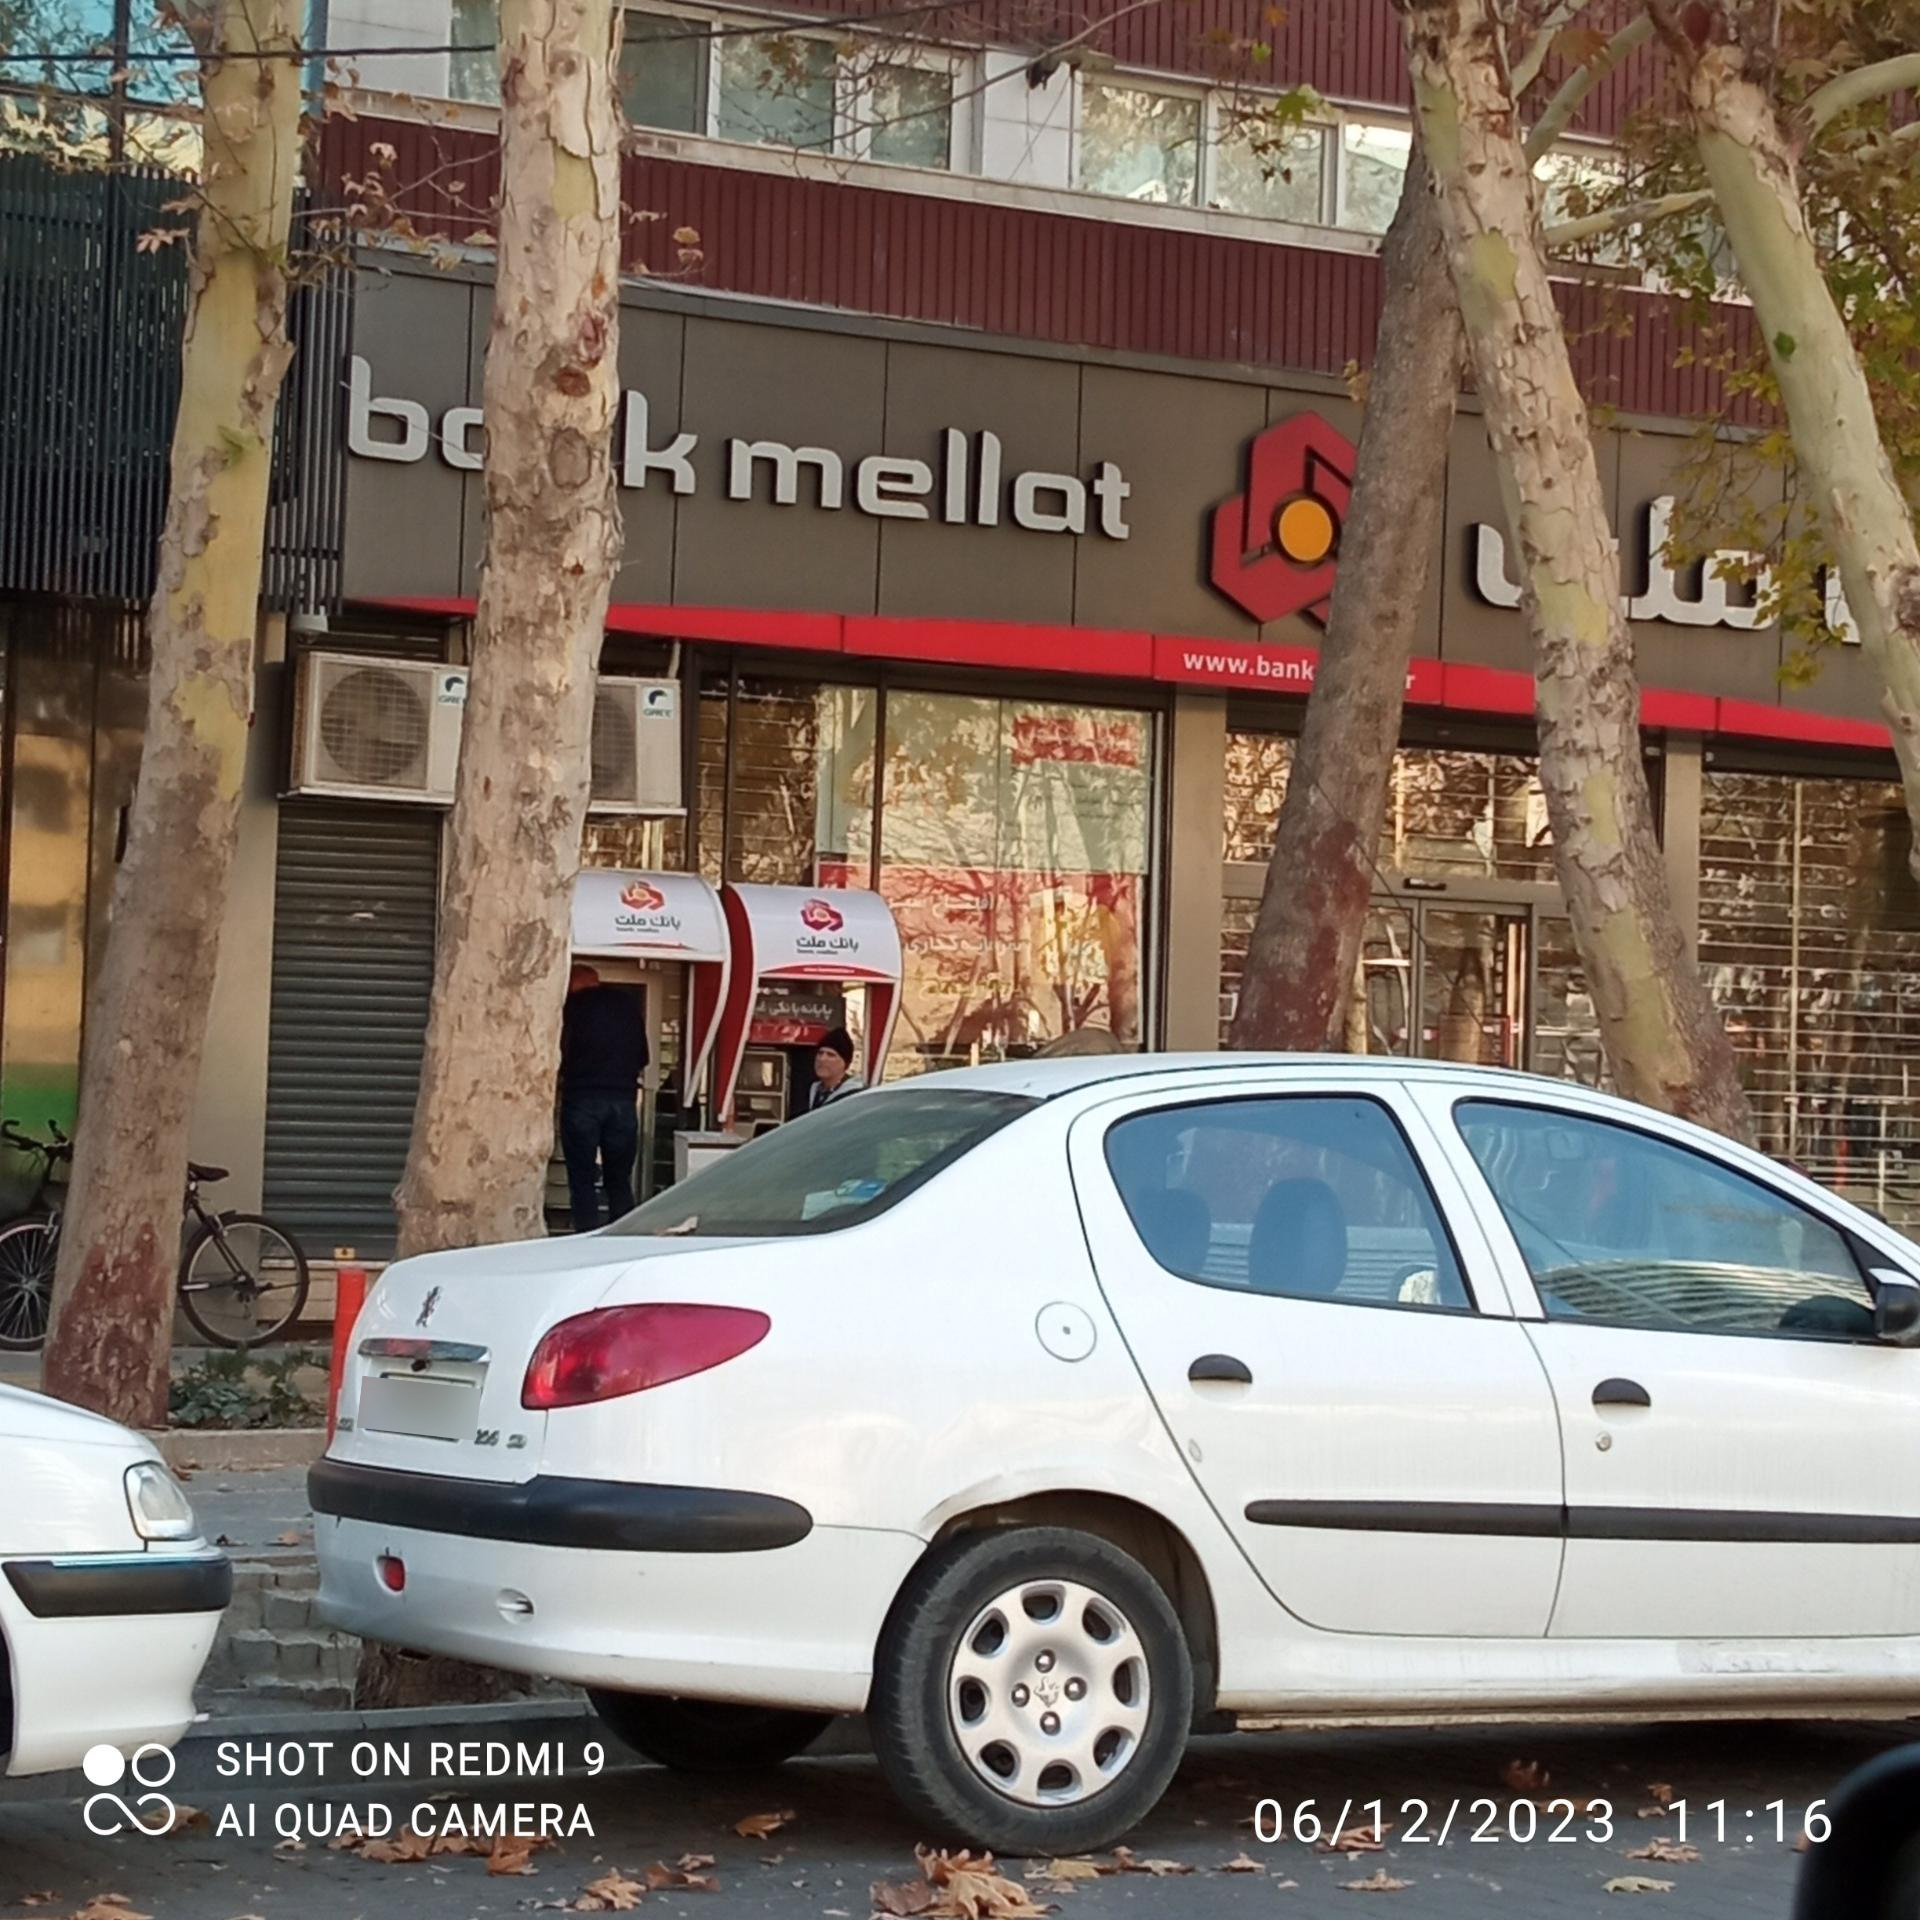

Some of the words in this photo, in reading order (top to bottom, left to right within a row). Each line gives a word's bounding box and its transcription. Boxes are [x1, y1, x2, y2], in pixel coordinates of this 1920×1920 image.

[349, 355, 698, 494] bak
[730, 427, 1131, 541] mellat
[614, 914, 647, 926] ملت
[796, 936, 826, 948] ملت
